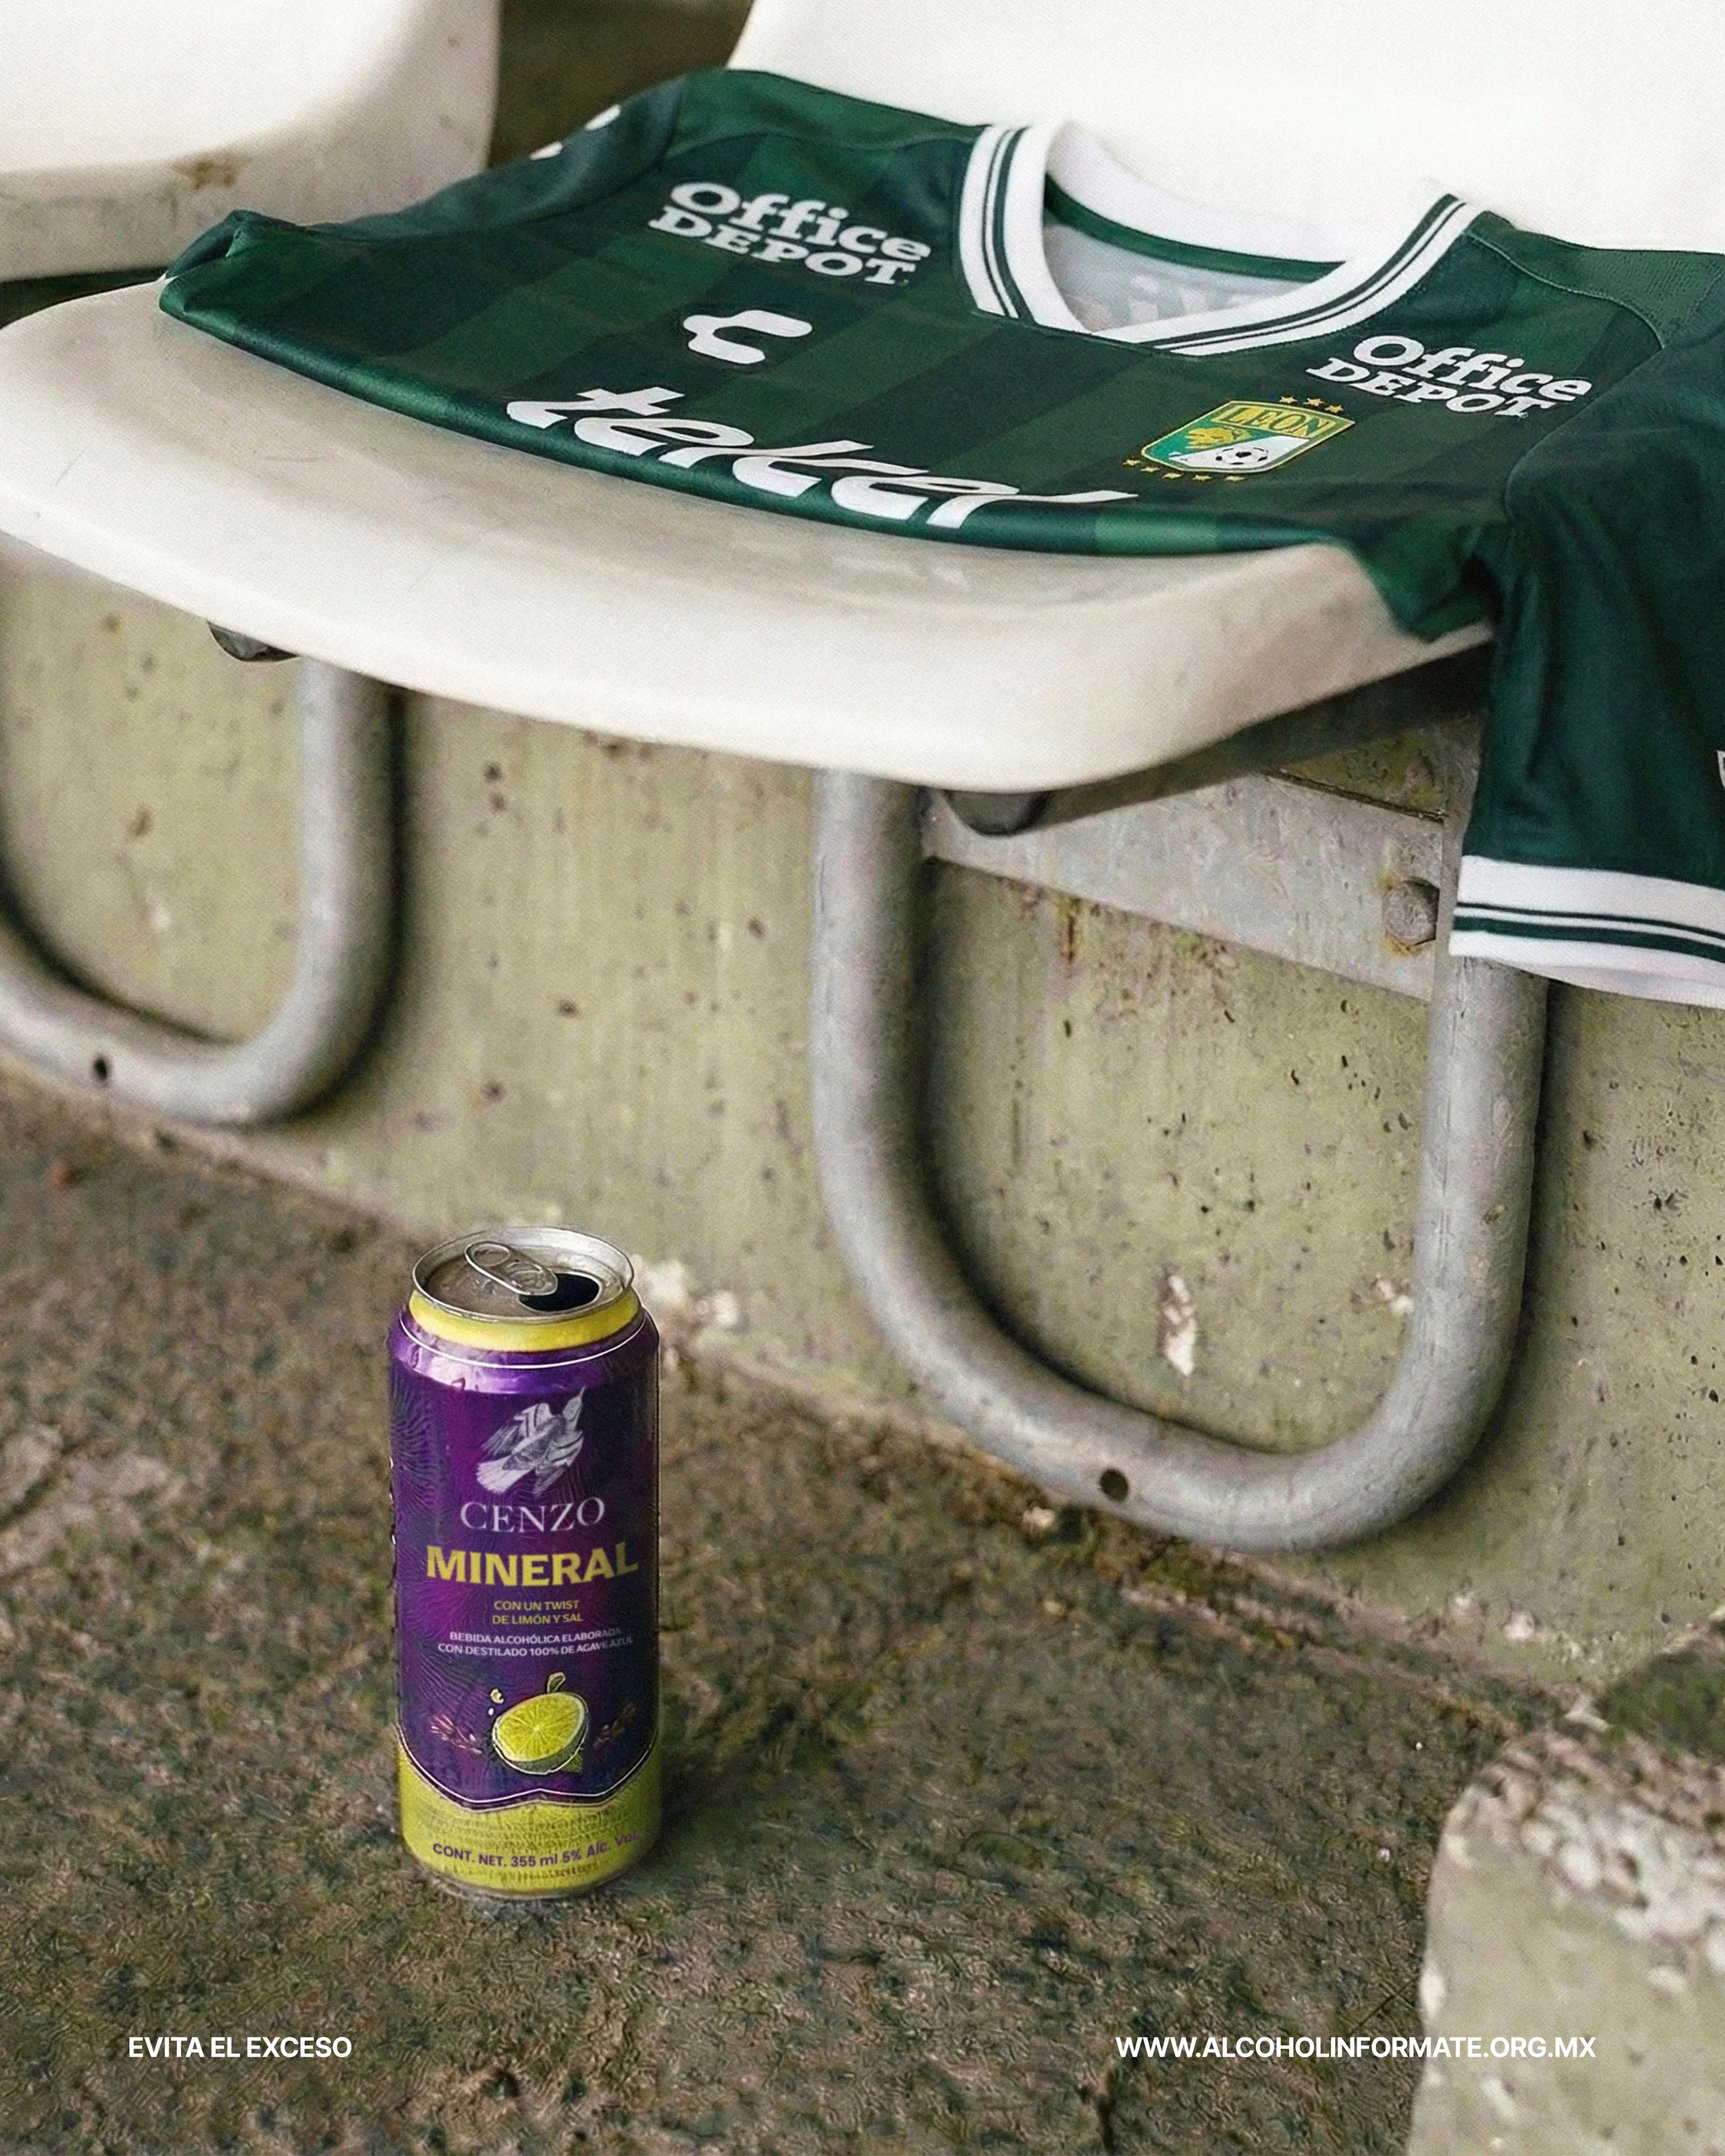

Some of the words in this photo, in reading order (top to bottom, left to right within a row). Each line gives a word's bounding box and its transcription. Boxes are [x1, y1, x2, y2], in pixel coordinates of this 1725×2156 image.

[671, 181, 931, 260] Office
[648, 205, 916, 284] DEPOT
[1353, 335, 1592, 401] Office
[1305, 358, 1557, 418] DEPOT
[460, 1496, 605, 1533] CENZO
[426, 1541, 639, 1587] MINERAL
[492, 1614, 509, 1624] DE
[512, 1612, 551, 1625] LIMÓN
[552, 1614, 561, 1623] Y
[563, 1612, 583, 1623] SAL
[493, 1600, 522, 1611] CON
[524, 1601, 542, 1611] UN
[544, 1599, 580, 1610] TWIST
[438, 1643, 463, 1654] CON
[465, 1645, 527, 1657] DESTILADO
[529, 1646, 560, 1657] 100%
[561, 1645, 575, 1655] DE
[576, 1641, 608, 1653] AGAVE
[449, 1631, 492, 1644] BEBIDA
[493, 1633, 560, 1645] ALCOHÓLICA
[562, 1628, 621, 1643] ELABORADA
[432, 1843, 475, 1863] CONT.
[478, 1854, 508, 1867] NET.
[511, 1856, 537, 1868] 355
[540, 1853, 558, 1867] ml
[562, 1848, 582, 1863] 5%
